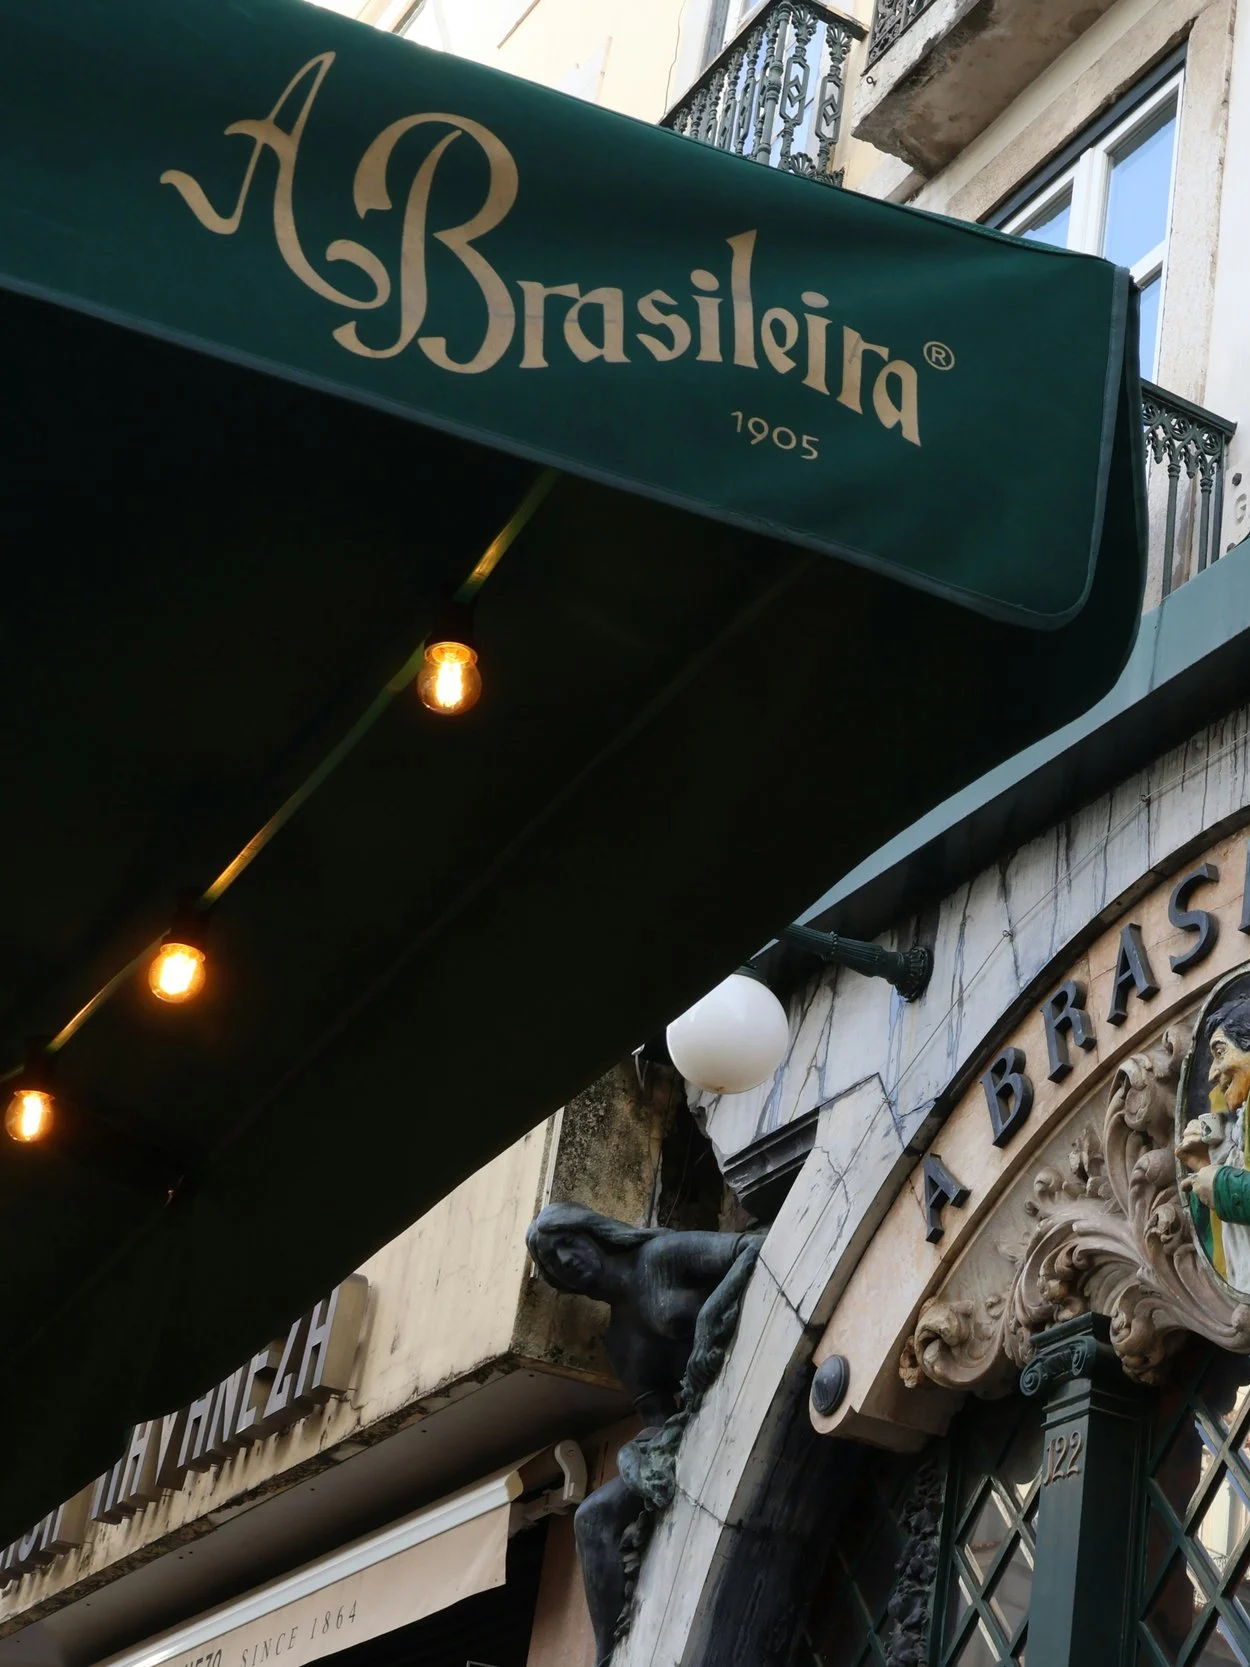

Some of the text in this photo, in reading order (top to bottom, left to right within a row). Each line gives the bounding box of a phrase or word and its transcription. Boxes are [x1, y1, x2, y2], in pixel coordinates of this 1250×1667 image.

[160, 50, 391, 310] A
[730, 410, 820, 460] 1905
[921, 1152, 972, 1243] A
[1043, 1431, 1083, 1486] 122
[240, 1626, 298, 1667] SINCE
[310, 1600, 358, 1640] 1864
